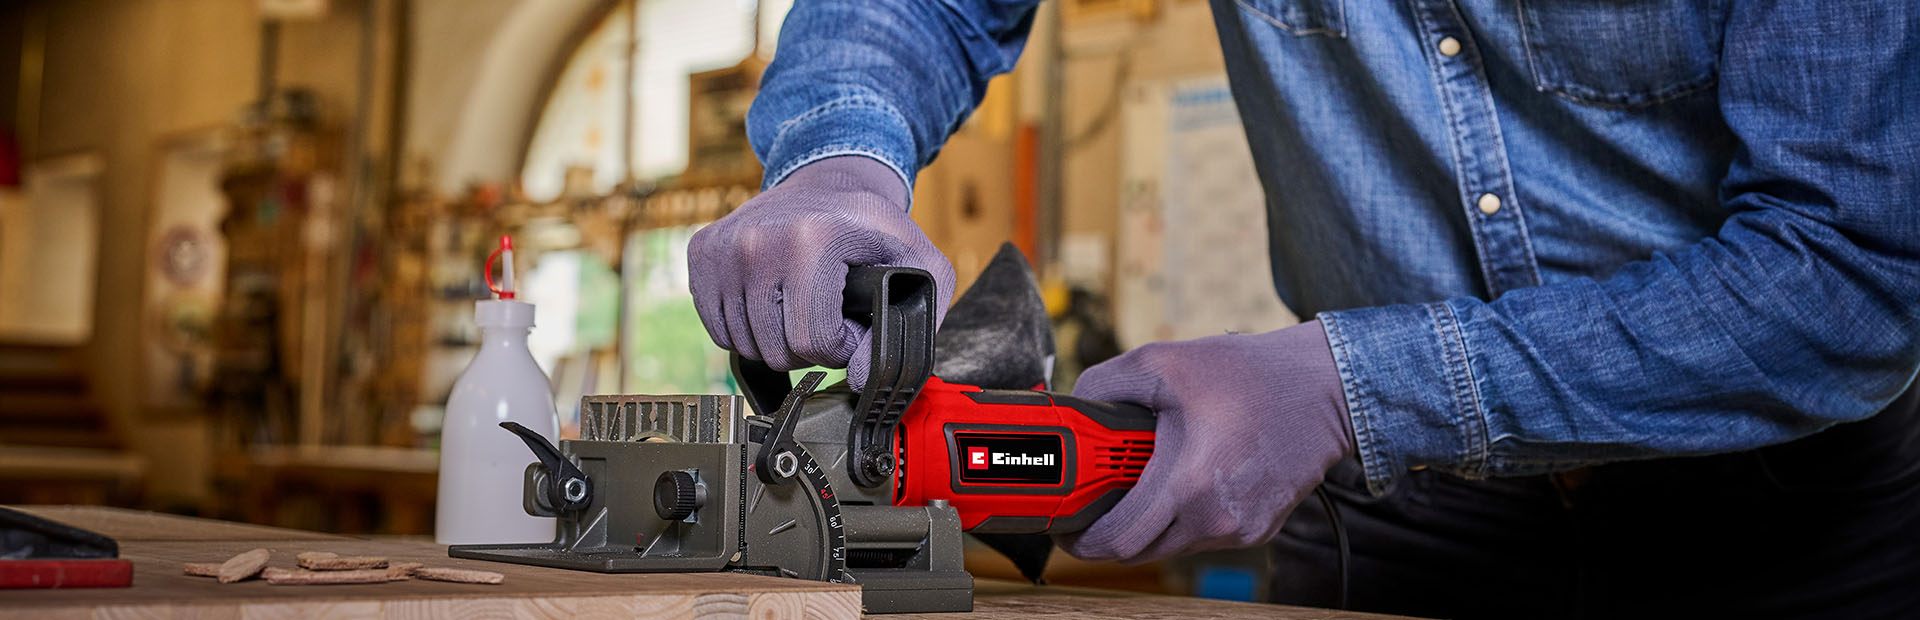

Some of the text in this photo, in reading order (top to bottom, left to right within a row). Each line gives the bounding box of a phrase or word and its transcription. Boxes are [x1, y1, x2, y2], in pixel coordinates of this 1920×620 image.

[992, 452, 1055, 466] Einhell
[805, 463, 813, 474] 30
[820, 488, 828, 499] 45
[829, 516, 837, 527] 60
[832, 547, 840, 558] 75
